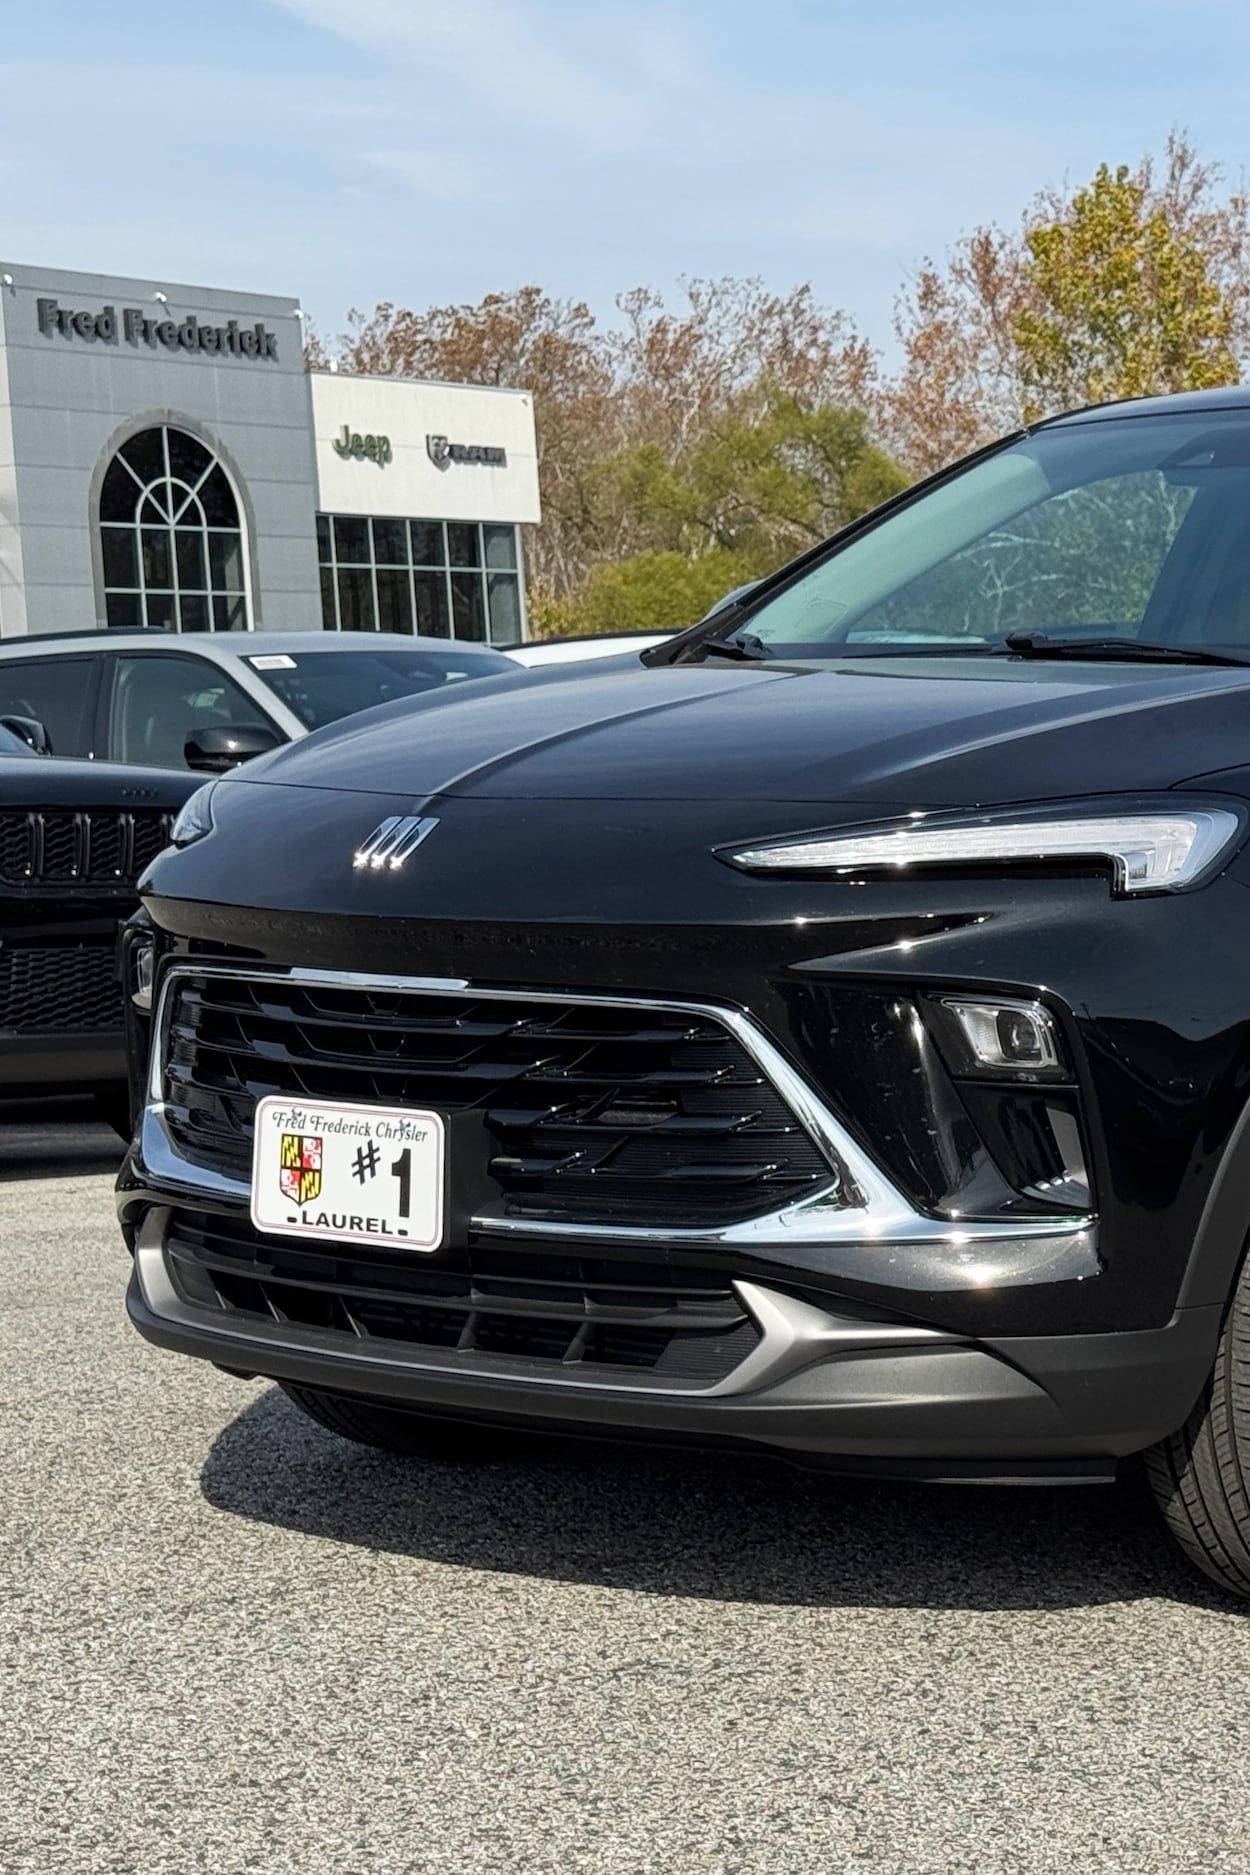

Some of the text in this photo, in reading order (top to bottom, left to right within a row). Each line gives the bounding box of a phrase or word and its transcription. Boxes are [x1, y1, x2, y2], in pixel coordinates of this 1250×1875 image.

[37, 298, 278, 361] Fred Frederick
[332, 425, 391, 468] Jeep
[272, 1110, 428, 1143] Fred Frederick Chrysler
